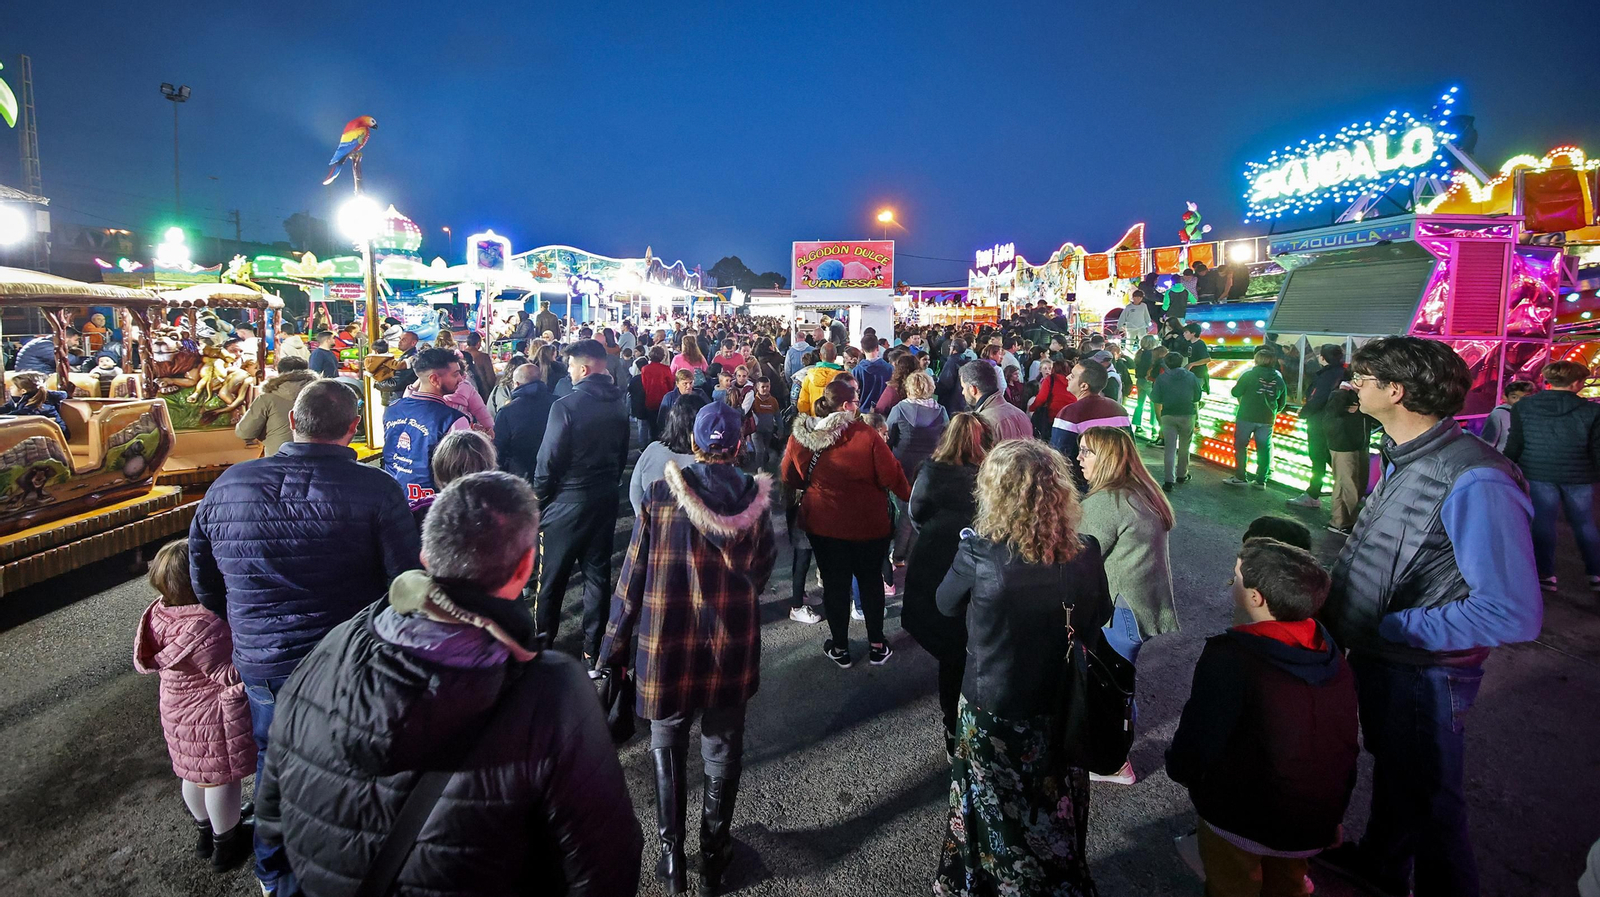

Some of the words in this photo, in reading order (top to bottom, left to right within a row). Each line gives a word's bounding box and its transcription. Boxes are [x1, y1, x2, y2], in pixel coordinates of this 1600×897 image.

[1250, 126, 1434, 203] SKANDALO
[1290, 230, 1382, 250] TAQUILLA
[853, 246, 890, 266] DULCE
[807, 279, 878, 289] VANESSA
[386, 417, 408, 430] Digital
[408, 418, 430, 437] Reality
